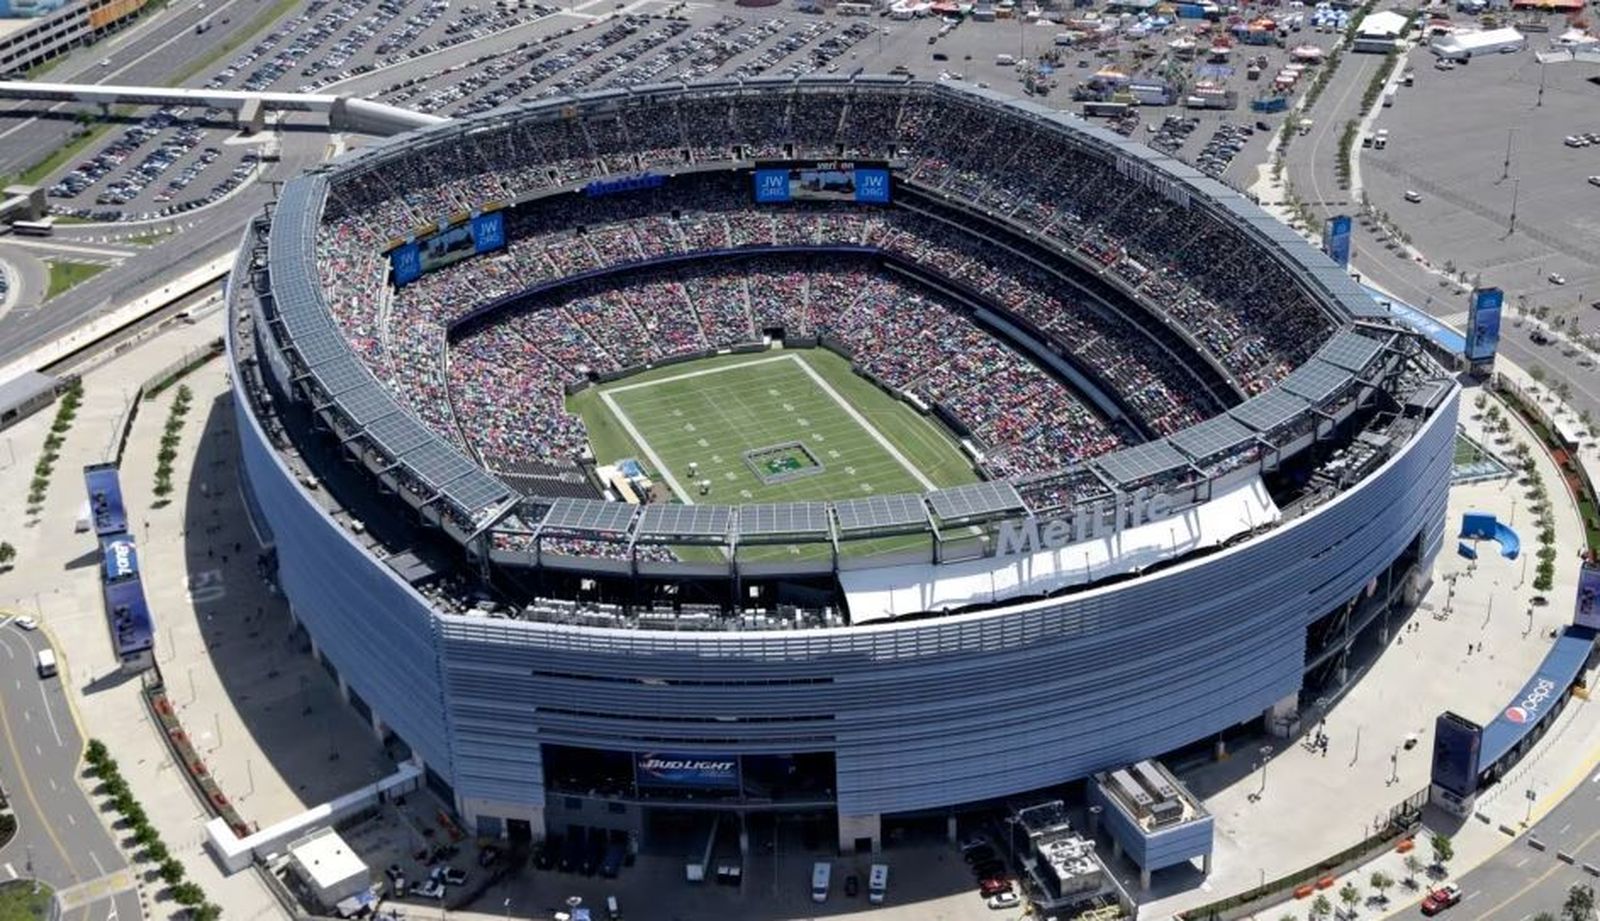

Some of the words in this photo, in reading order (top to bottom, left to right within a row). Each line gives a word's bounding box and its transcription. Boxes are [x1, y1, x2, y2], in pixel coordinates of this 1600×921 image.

[817, 161, 855, 170] verion
[761, 176, 783, 187] JW
[862, 176, 884, 186] JW
[479, 220, 498, 236] JW
[995, 487, 1172, 557] MetLife
[1521, 678, 1555, 711] pepsi
[648, 759, 683, 769] BUD
[684, 760, 735, 770] LIGHT
